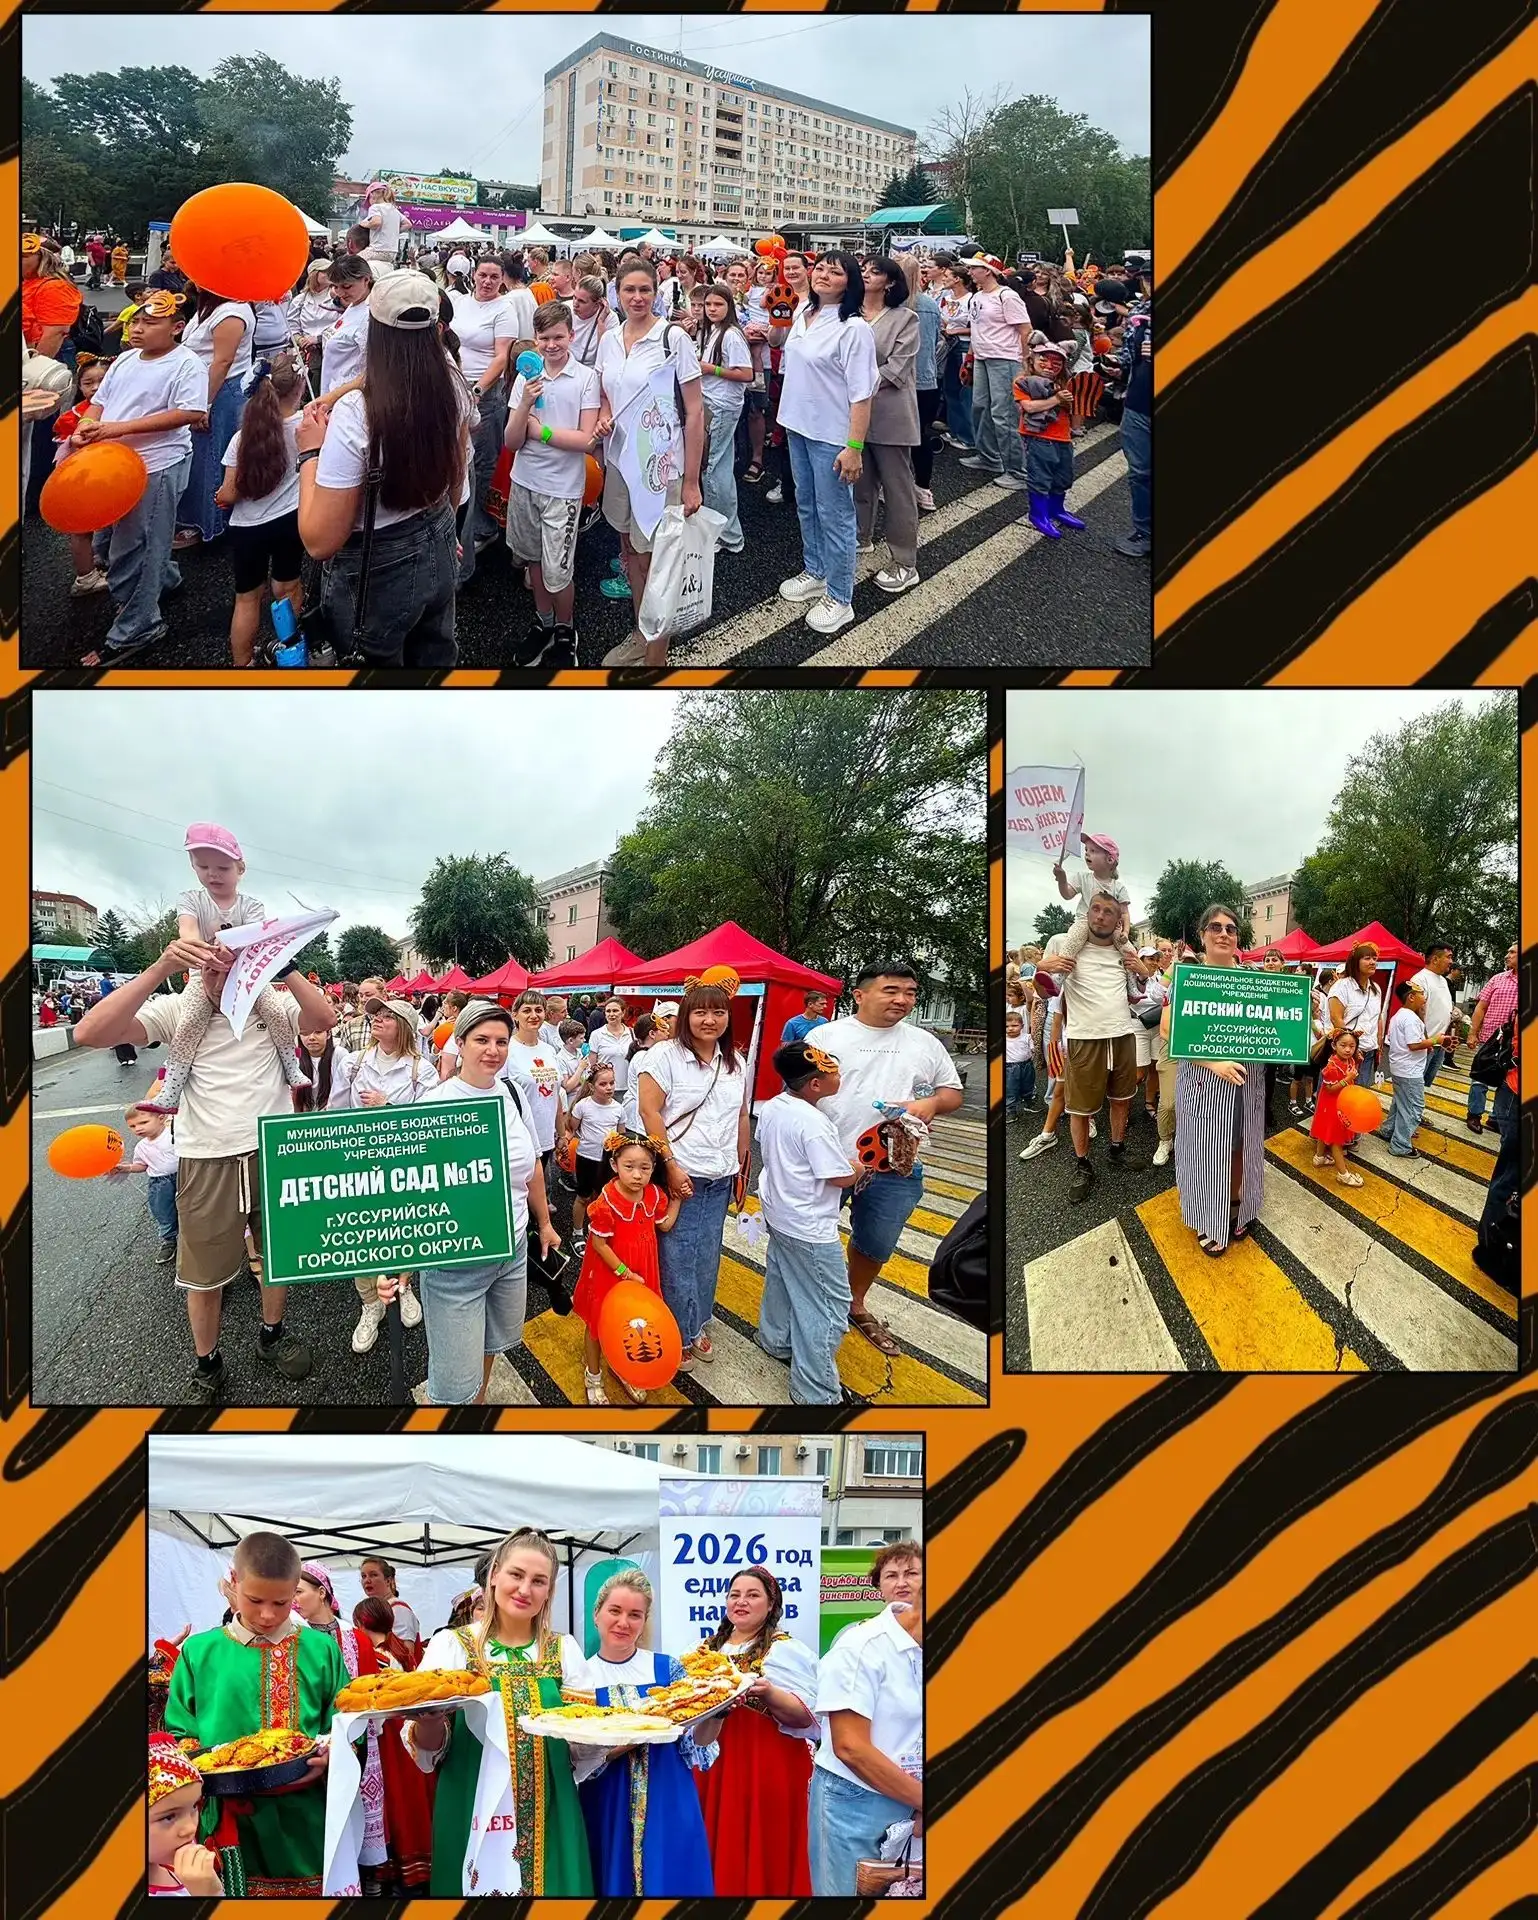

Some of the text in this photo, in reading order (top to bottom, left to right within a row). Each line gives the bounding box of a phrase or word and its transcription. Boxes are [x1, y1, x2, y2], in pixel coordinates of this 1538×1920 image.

[629, 43, 689, 68] ГОСТИНИЦА
[422, 184, 437, 192] НАС
[438, 185, 469, 194] ВКУСНО
[1183, 980, 1303, 995] ДОШКОЛЬНОЕ ОБРАЗОВАТЕЛЬНОЕ
[1189, 973, 1299, 987] МУНИЦИПАЛЬНОЕ БЮДЖЕТНОЕ
[1221, 990, 1269, 1000] УЧРЕЖДЕНИЕ
[1181, 1000, 1303, 1021] ДЕТСКИЙ САД №15
[1207, 1023, 1278, 1035] г.УССУРИЙСКА
[1203, 1034, 1281, 1046] УССУРИЙСКОГО
[1188, 1044, 1293, 1057] ГОРОДСКОГО ОКРУГА
[286, 1112, 479, 1140] МУНИЦИПАЛЬНОЕ БЮДЖЕТНОЕ
[277, 1124, 489, 1156] ДОШКОЛЬНОЕ ОБРАЗОВАТЕЛЬНОЕ
[343, 1143, 427, 1161] УЧРЕЖДЕНИЕ
[279, 1158, 494, 1207] ДЕТСКИЙ САД №15
[326, 1201, 451, 1229] г.УССУРИЙСКА
[320, 1220, 459, 1247] УССУРИЙСКОГО
[297, 1236, 484, 1269] ГОРОДСКОГО ОКРУГА
[672, 1532, 813, 1567] 2026 год
[684, 1576, 802, 1597] едива
[821, 1575, 858, 1587] Дружба
[820, 1591, 861, 1602] динство
